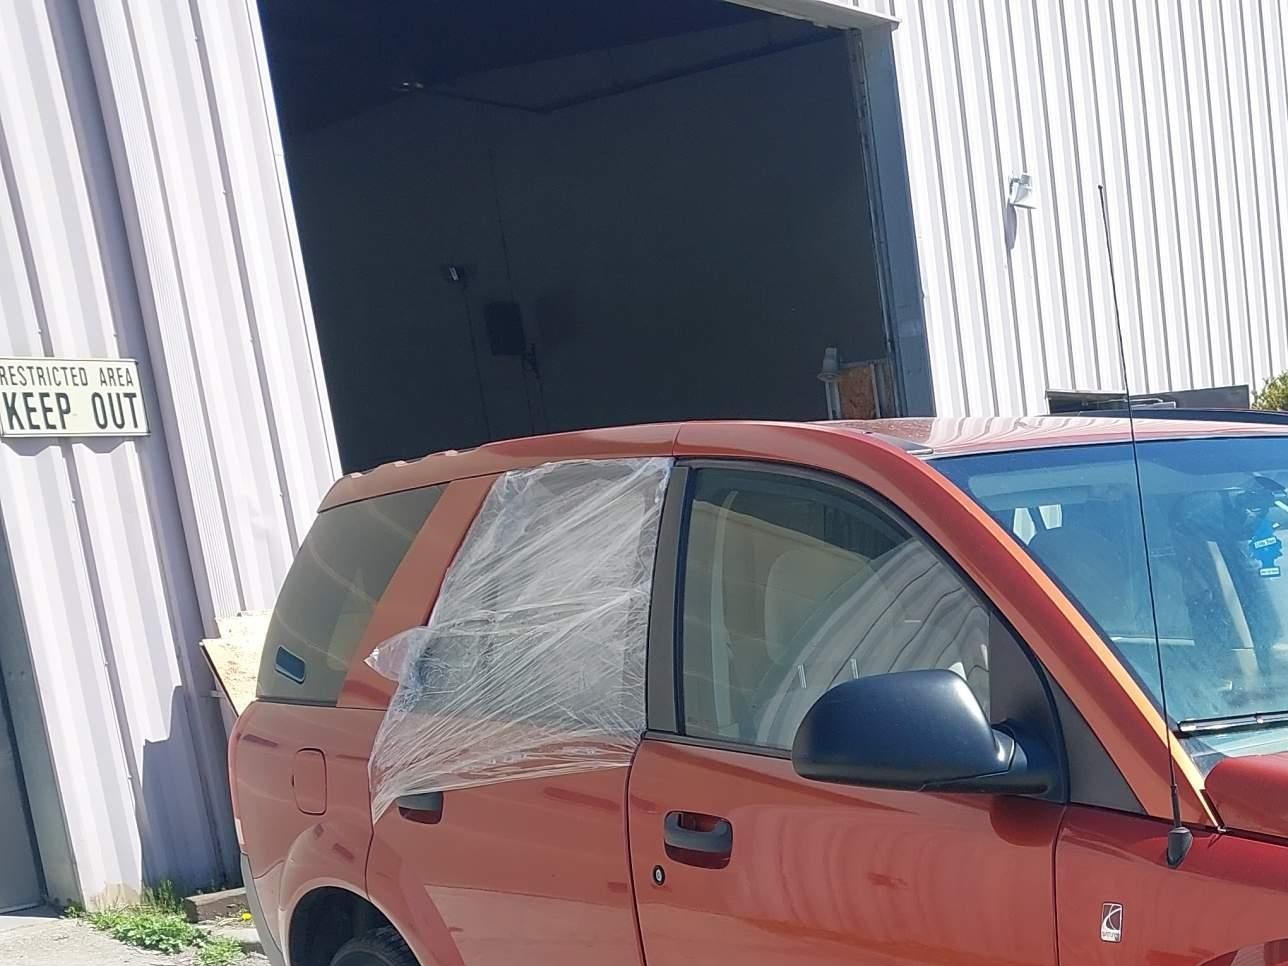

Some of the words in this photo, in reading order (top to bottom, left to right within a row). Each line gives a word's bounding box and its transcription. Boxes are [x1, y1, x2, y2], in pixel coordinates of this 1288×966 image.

[0, 365, 88, 386] RESTRICTED
[99, 367, 134, 387] AREA
[2, 391, 71, 430] KEEP
[91, 391, 138, 430] OUT
